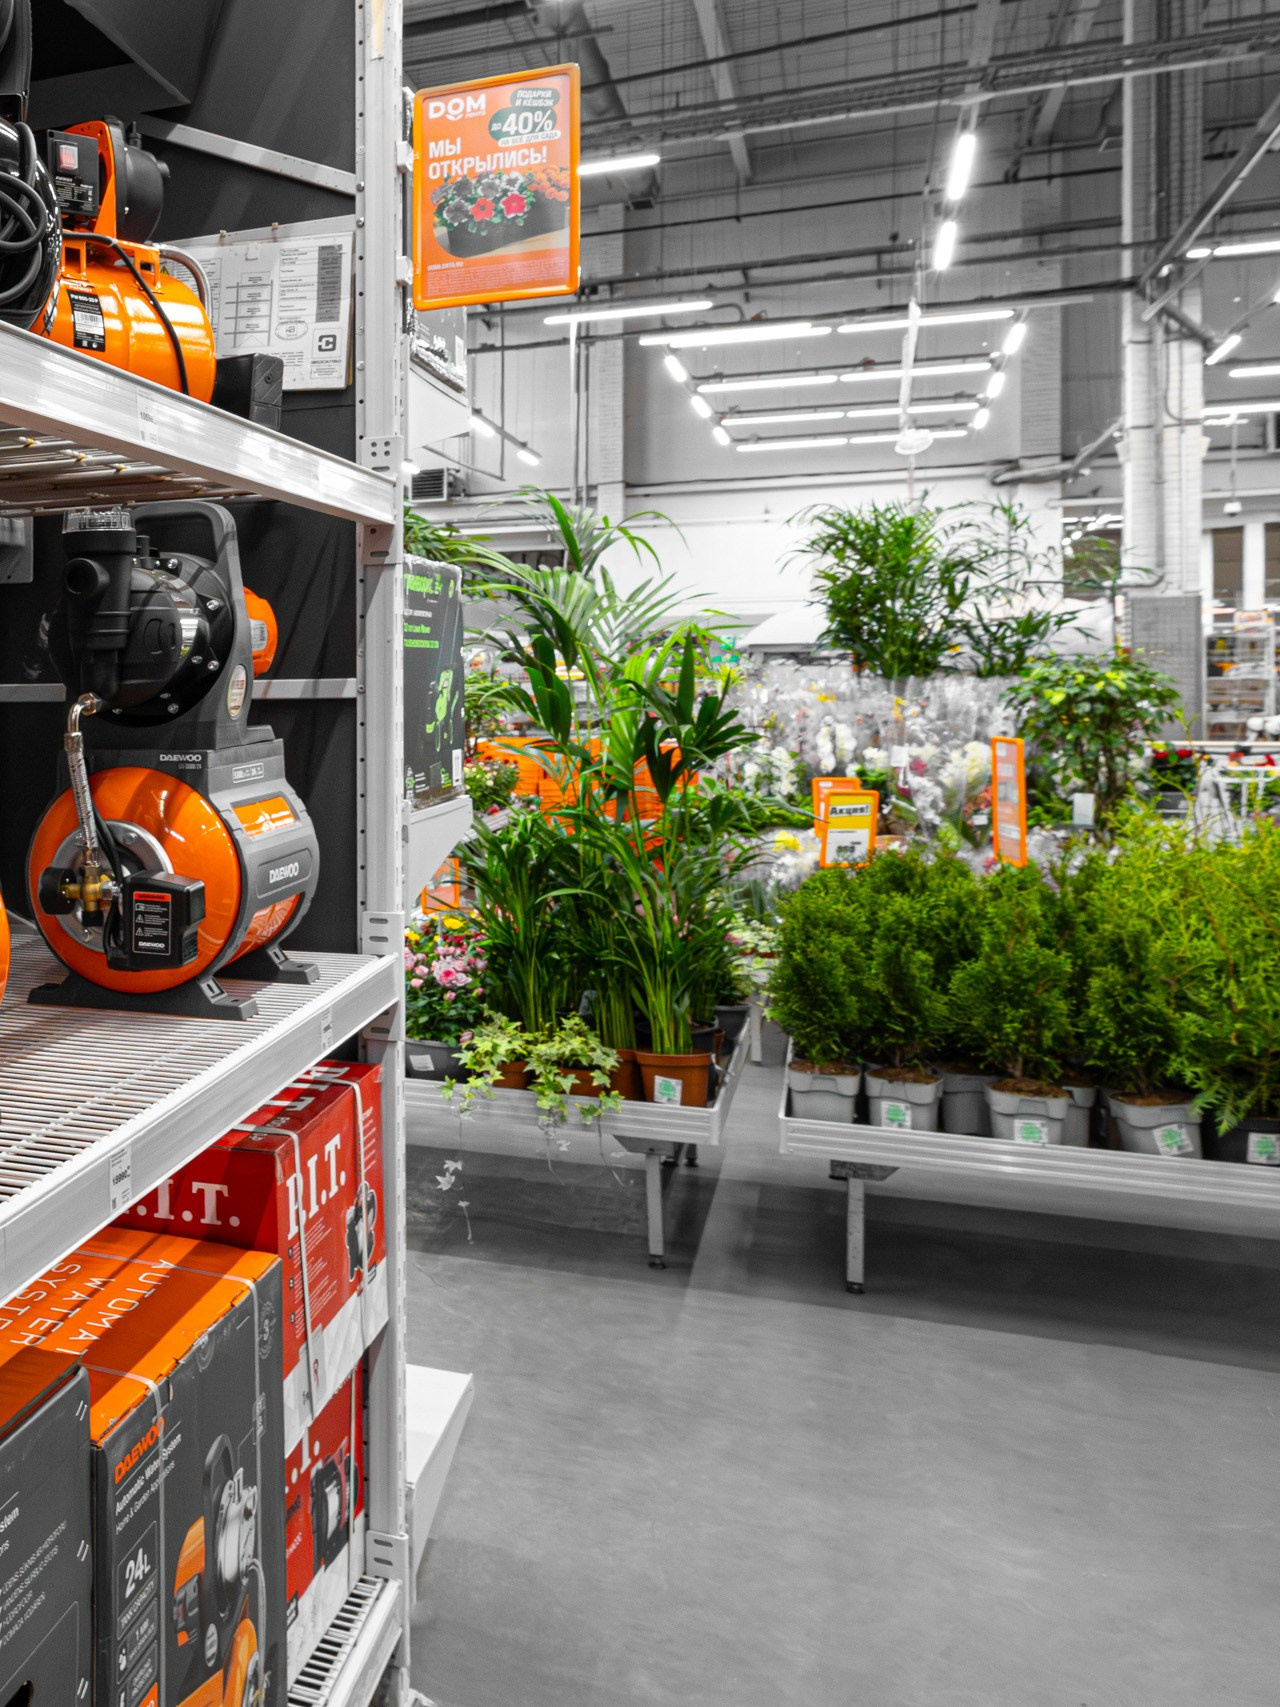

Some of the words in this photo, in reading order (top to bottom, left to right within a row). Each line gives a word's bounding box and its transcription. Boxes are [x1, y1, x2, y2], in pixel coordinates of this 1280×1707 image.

[502, 109, 553, 135] 40%
[429, 138, 461, 158] МЫ
[428, 146, 547, 179] ОТКРЫЛИСЬ!
[830, 805, 869, 815] Акция!
[269, 862, 299, 883] DAEWOO
[10, 1276, 115, 1347] WATER
[115, 1416, 165, 1484] DAEWOO
[116, 1475, 144, 1516] Automatic
[116, 1514, 130, 1535] Home
